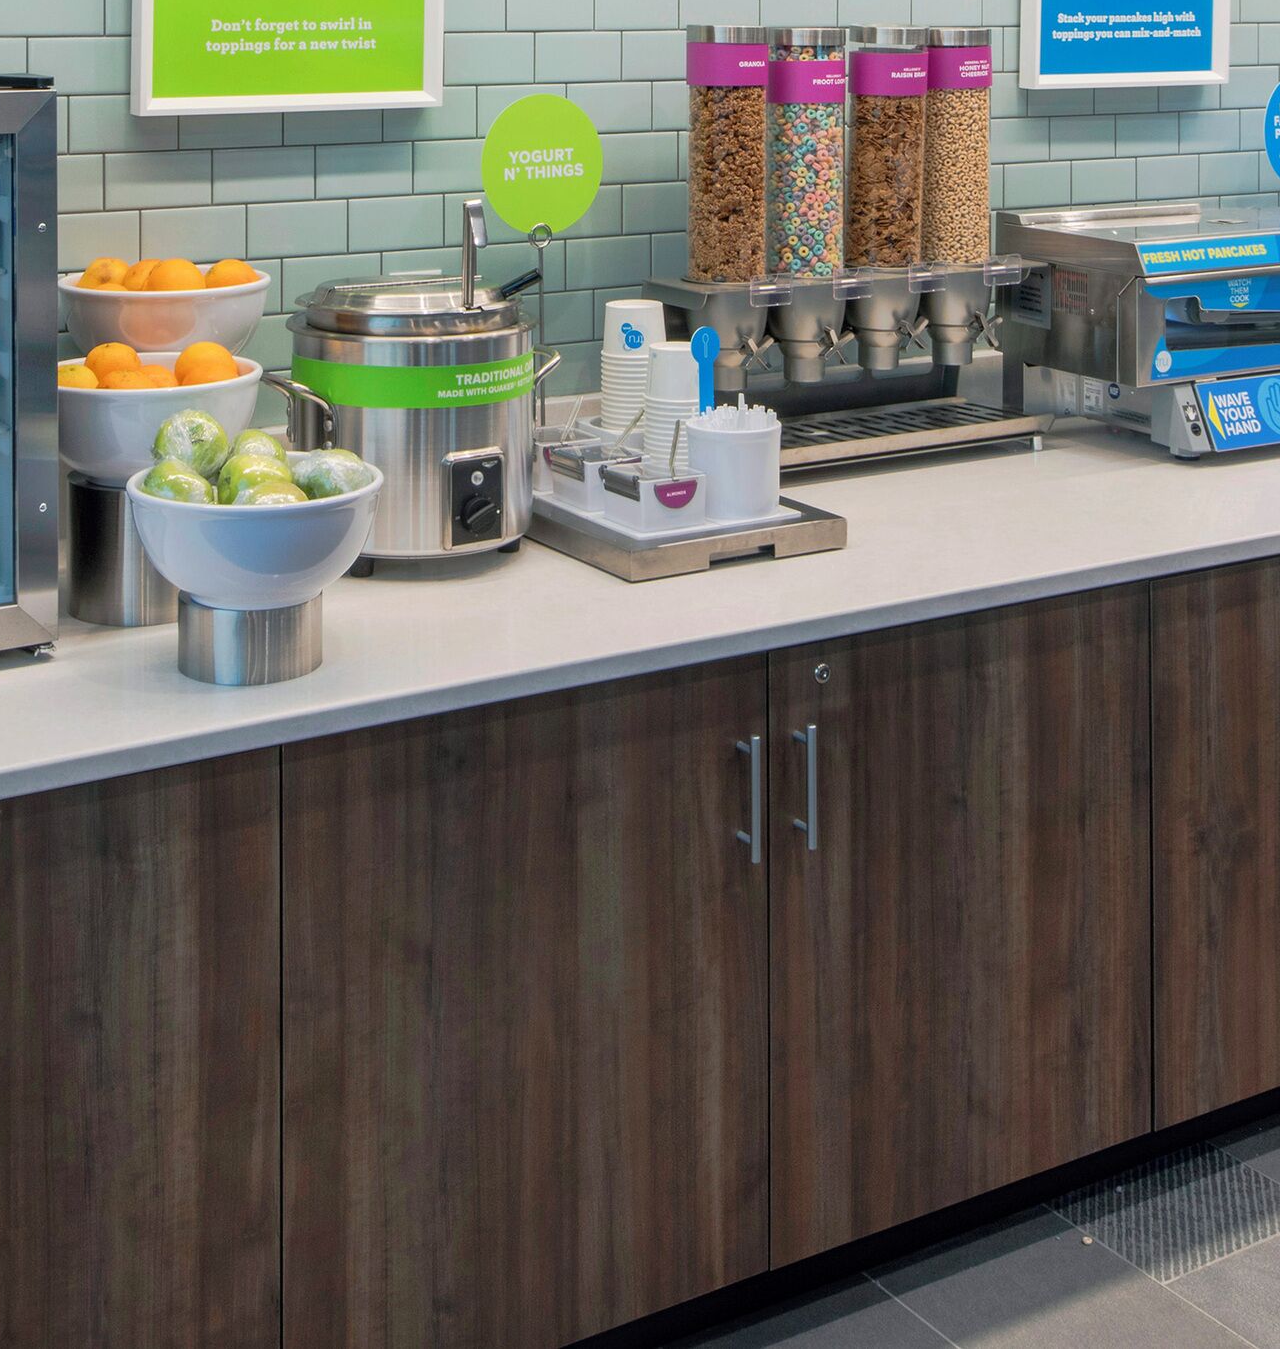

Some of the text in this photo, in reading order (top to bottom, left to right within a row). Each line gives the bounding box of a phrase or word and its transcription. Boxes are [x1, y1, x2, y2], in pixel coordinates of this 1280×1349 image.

[255, 17, 299, 34] forget
[303, 18, 317, 32] to
[320, 17, 355, 30] swirl
[358, 16, 373, 30] in
[1058, 11, 1197, 26] Stack your pancakes high with
[1052, 27, 1202, 41] toppings you can mix-and-match
[205, 37, 376, 55] toppings for a new twist
[738, 60, 766, 68] GRANOLA
[508, 148, 574, 165] YOGURT
[526, 163, 584, 180] THINGS
[1143, 244, 1267, 265] FRESH HOT PANCAKES
[1227, 278, 1252, 287] WATCH
[1230, 286, 1249, 295] THEM
[1229, 294, 1250, 303] COOK
[456, 365, 524, 387] TRADITIONAL
[437, 389, 465, 399] MADE
[465, 386, 487, 398] WITH
[1213, 391, 1251, 408] WAVE
[1219, 405, 1256, 422] YOUR
[1224, 419, 1261, 436] HAND
